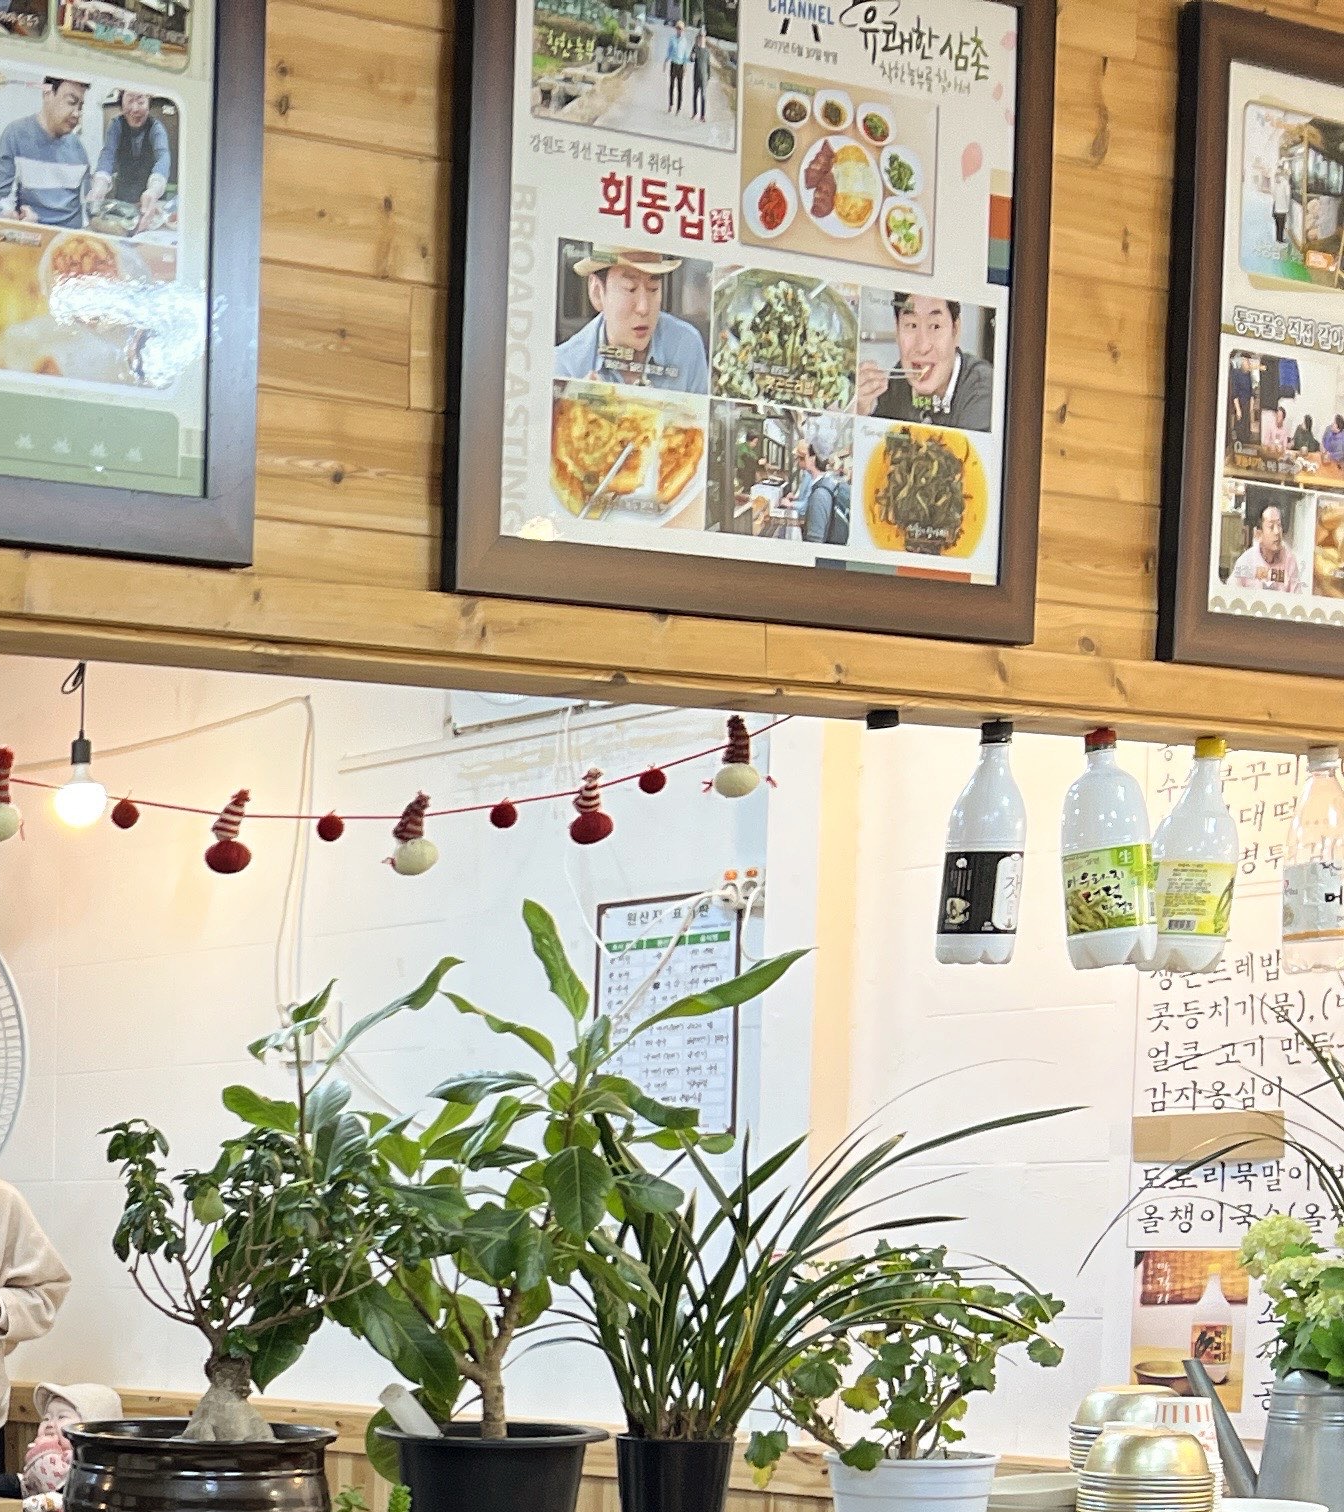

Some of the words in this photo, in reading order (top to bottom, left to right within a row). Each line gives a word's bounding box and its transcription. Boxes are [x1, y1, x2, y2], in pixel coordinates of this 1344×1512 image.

[767, 0, 836, 26] CHANNEL
[859, 4, 940, 65] 유쾌한
[939, 26, 990, 81] 삼촌
[597, 171, 707, 241] 회동집
[1233, 305, 1287, 342] 통곡물을
[1288, 316, 1315, 348] 직접
[502, 181, 539, 537] BROADCASTING
[1147, 1040, 1202, 1074] 얼큰
[1214, 1034, 1265, 1067] 고기
[1144, 1075, 1284, 1114] 감자옹심이
